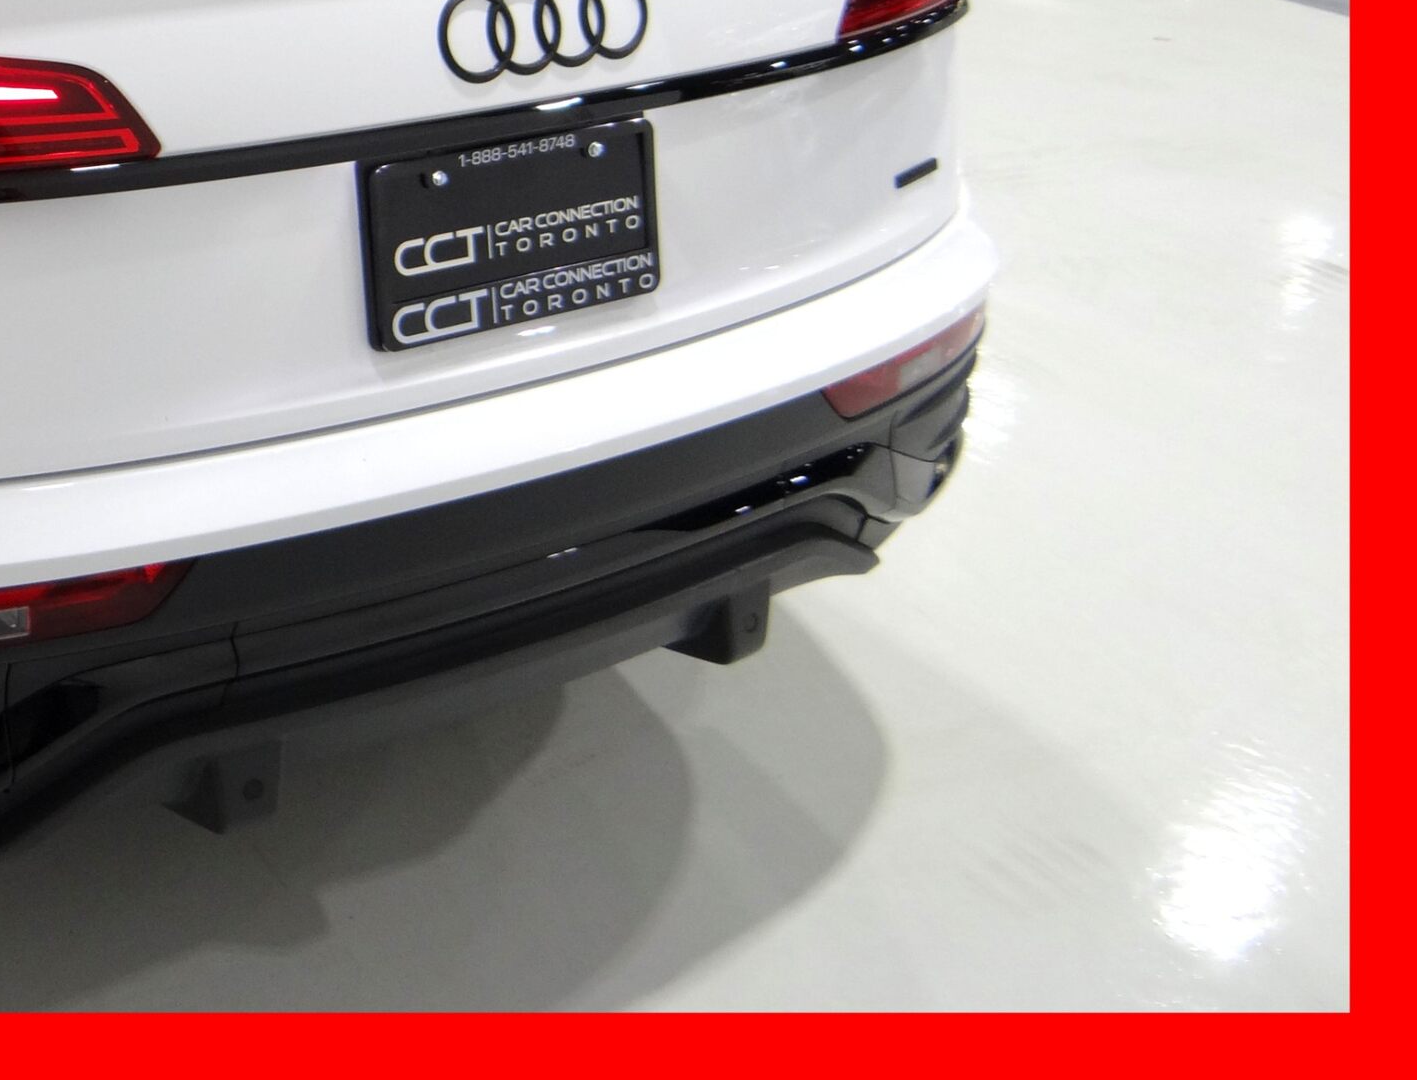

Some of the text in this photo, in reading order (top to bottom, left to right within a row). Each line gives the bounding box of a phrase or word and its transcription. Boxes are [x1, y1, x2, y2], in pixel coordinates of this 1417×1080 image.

[458, 134, 576, 167] 1-888-541-8748
[494, 195, 640, 237] CAR CONNECTION
[495, 214, 641, 257] TORONTO
[394, 226, 485, 276] CCT
[500, 252, 654, 300] CAR CONNECTION
[501, 273, 656, 321] TORONTO
[392, 289, 489, 344] CCT
